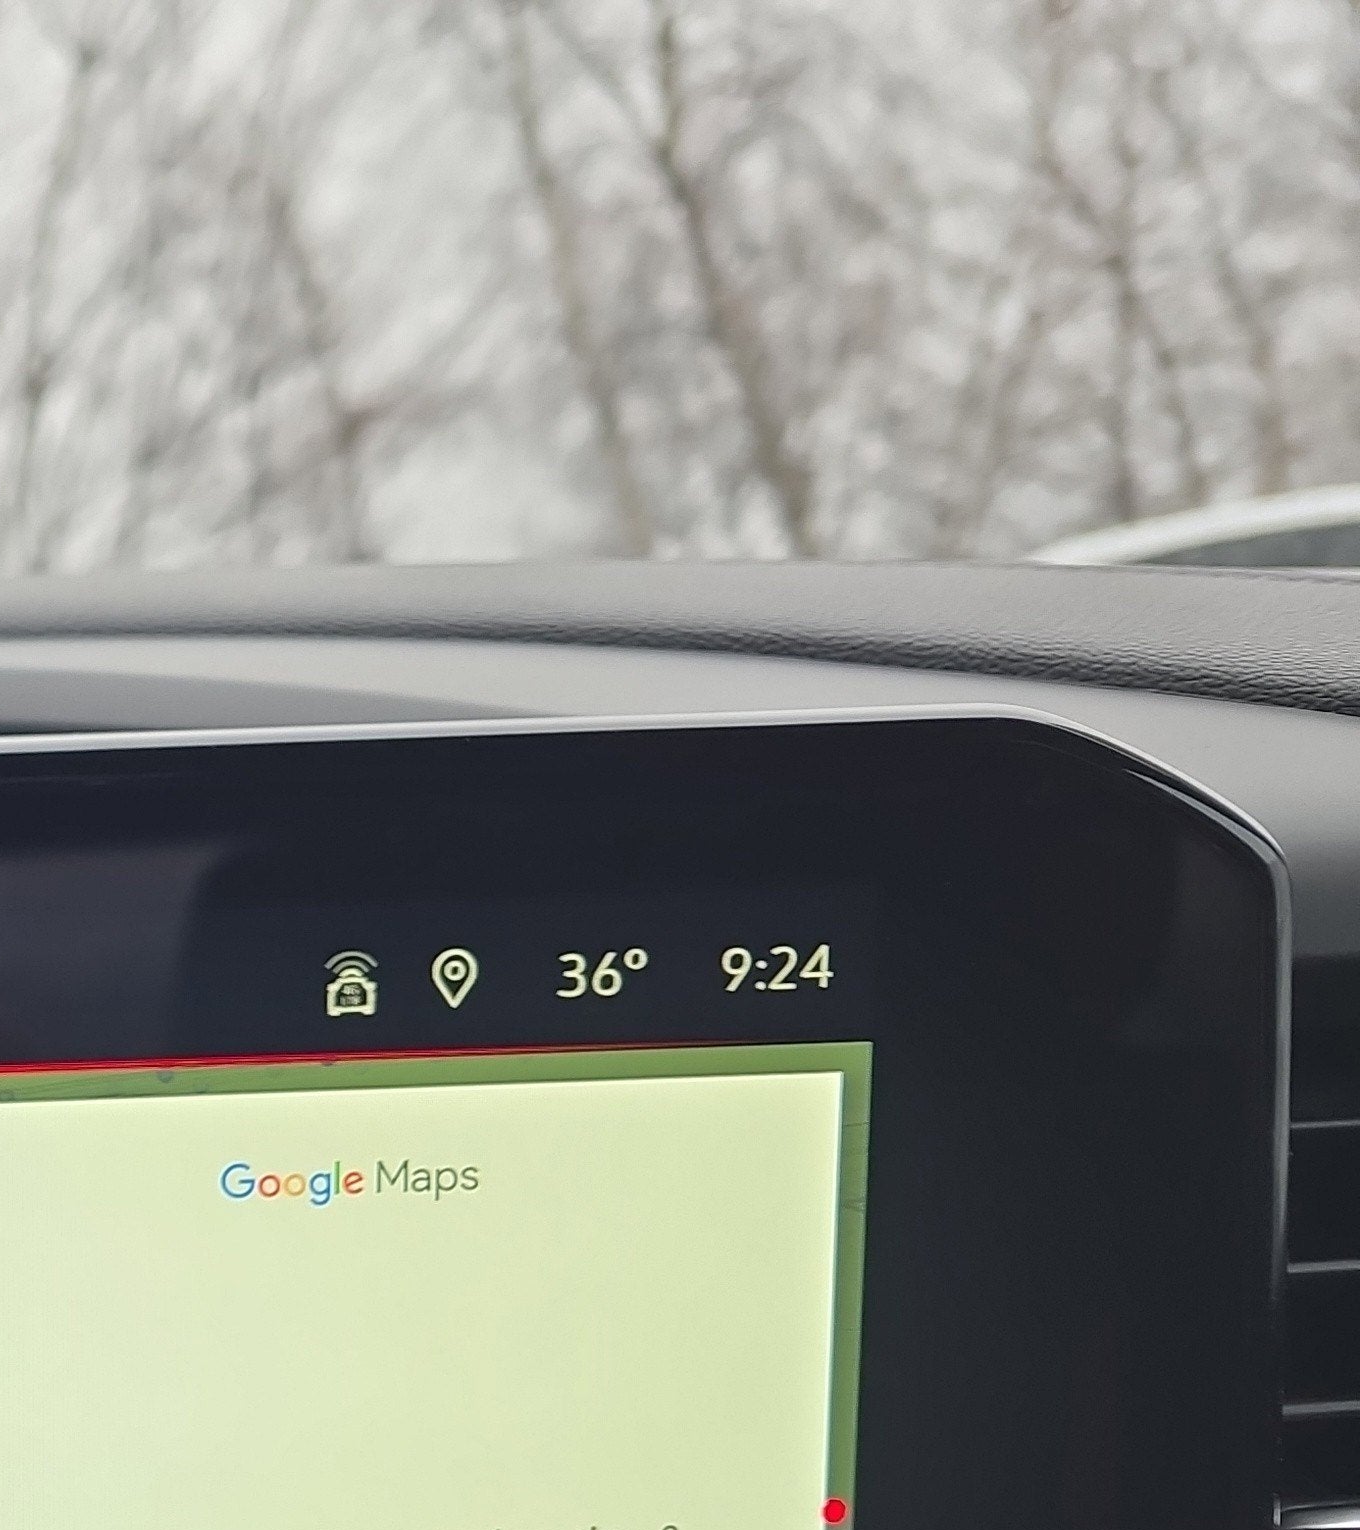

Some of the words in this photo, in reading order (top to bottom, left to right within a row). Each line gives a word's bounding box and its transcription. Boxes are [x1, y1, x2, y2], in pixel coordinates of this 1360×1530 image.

[556, 948, 648, 998] 36°
[721, 944, 834, 992] 9:24
[220, 1161, 364, 1207] Google
[376, 1159, 479, 1202] Maps
